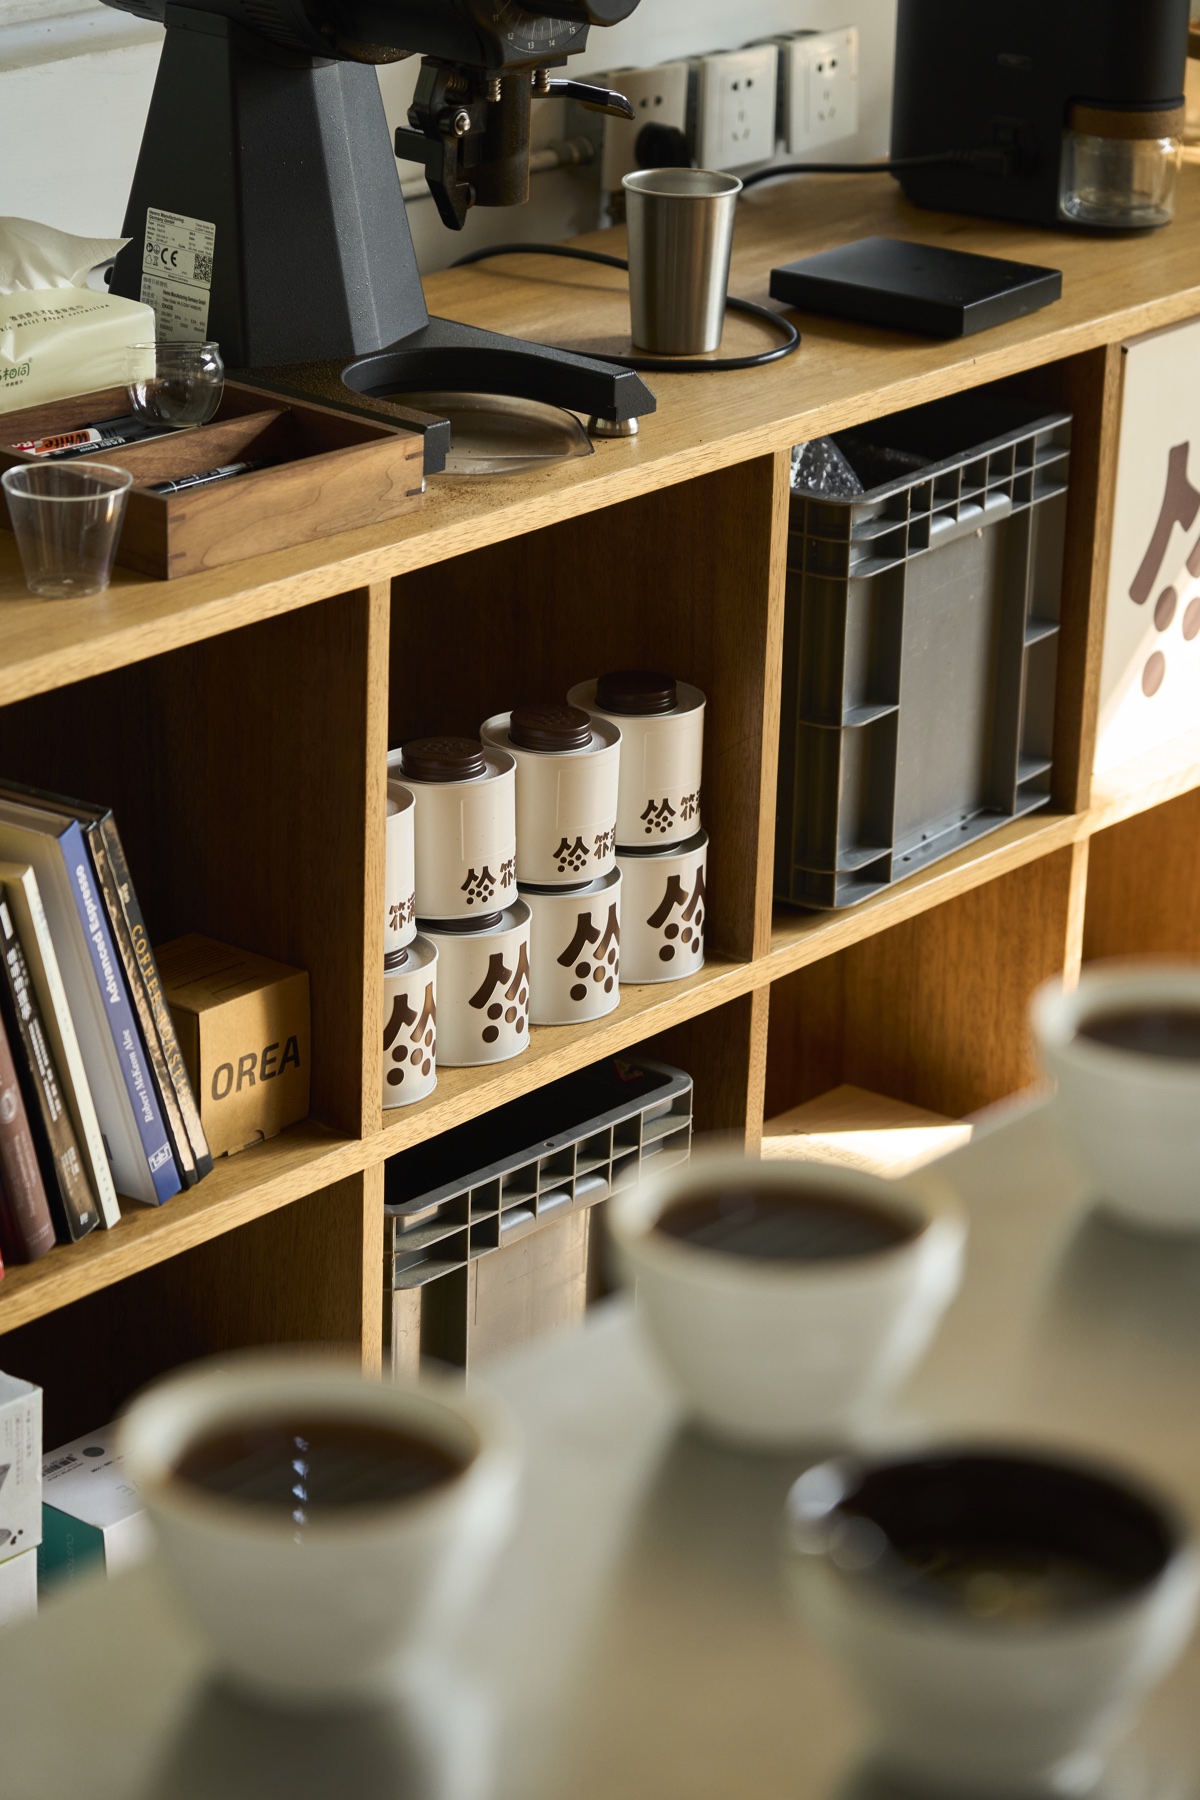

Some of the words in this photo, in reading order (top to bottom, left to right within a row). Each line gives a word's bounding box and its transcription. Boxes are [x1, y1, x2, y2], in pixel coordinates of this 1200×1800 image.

[507, 32, 514, 40] 12
[527, 41, 535, 49] 13
[548, 39, 556, 47] 14
[569, 26, 576, 34] 15
[44, 430, 88, 449] White
[75, 864, 100, 934] Espresso
[92, 930, 121, 1004] Advanced
[131, 924, 163, 1008] COFFEE
[122, 1029, 135, 1051] Aloe
[211, 1035, 301, 1101] OREA
[135, 1093, 154, 1123] Robert
